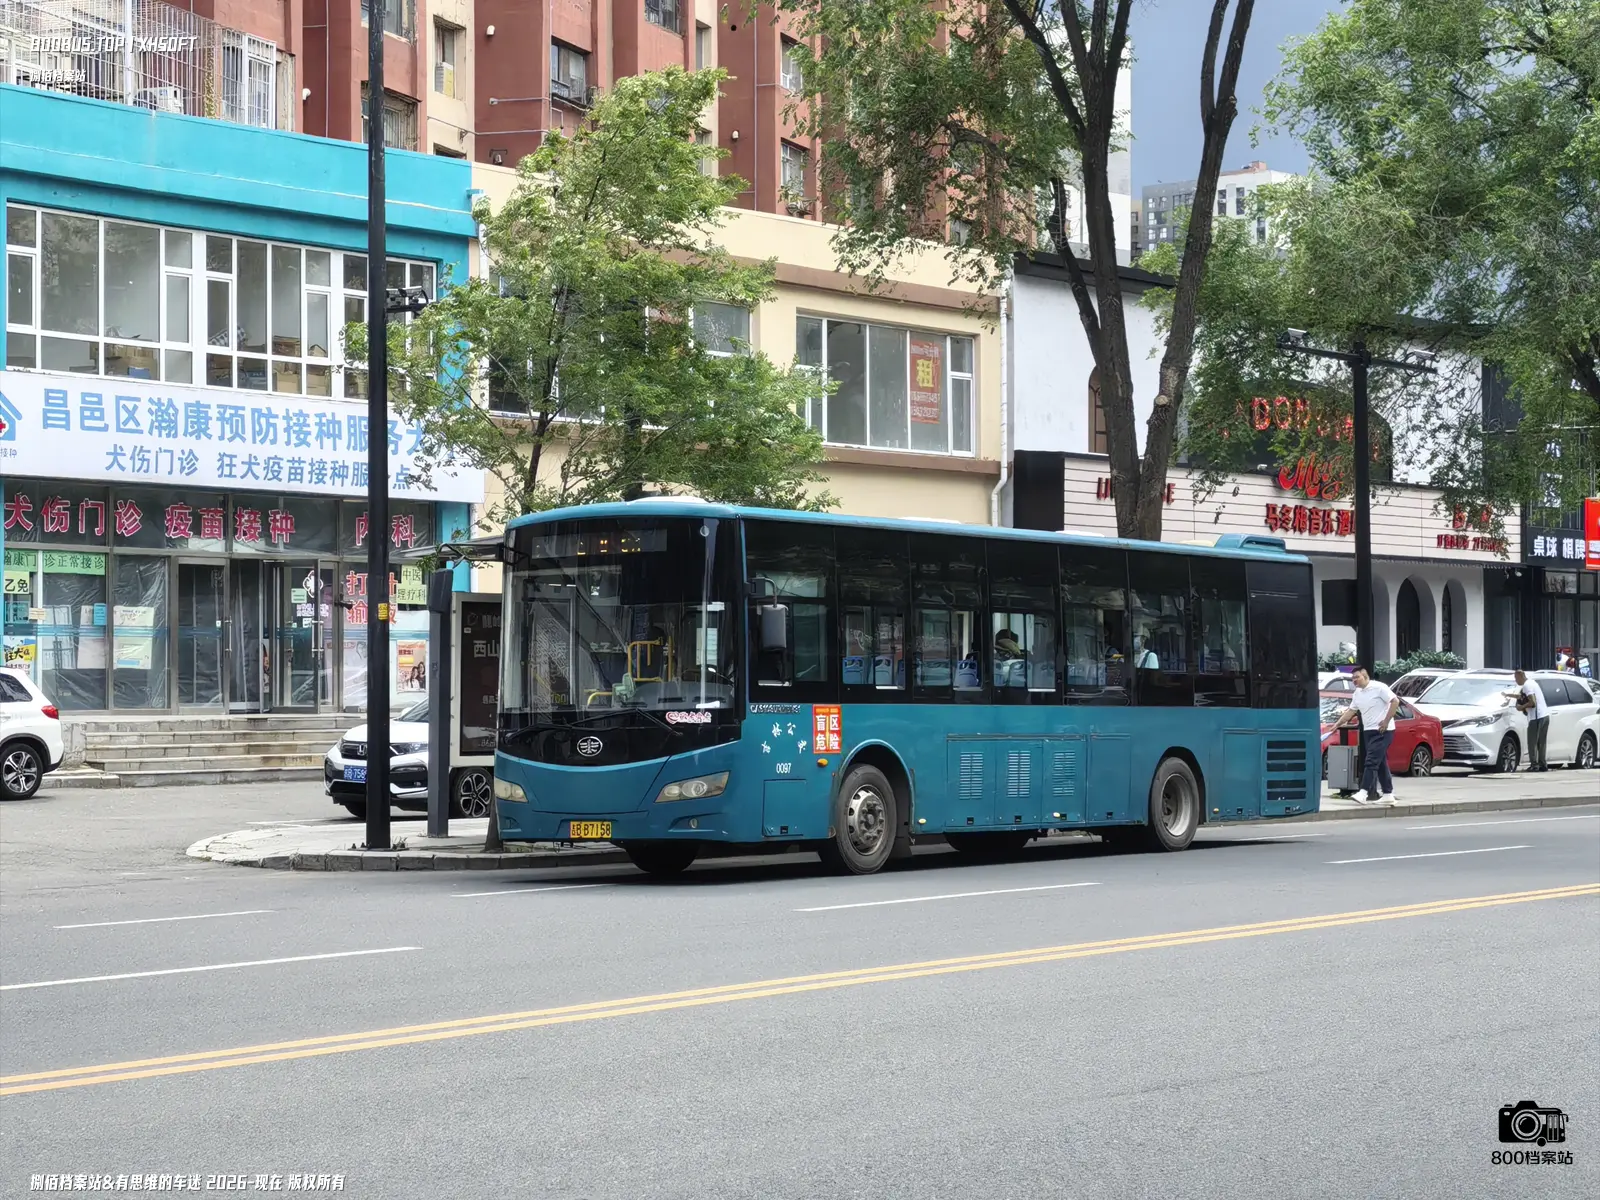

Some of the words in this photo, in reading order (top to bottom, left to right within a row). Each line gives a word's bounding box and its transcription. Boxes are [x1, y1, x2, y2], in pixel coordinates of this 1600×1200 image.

[42, 388, 455, 461] 昌邑区瀚康预防接种服务大
[105, 443, 200, 477] 犬伤门诊
[216, 451, 411, 490] 狂犬疫苗接种服点
[4, 492, 143, 537] 犬伤门诊
[164, 502, 296, 544] 疫苗接种
[1265, 503, 1356, 536] 马冬梅音乐酒
[1533, 535, 1558, 558] 桌球
[4, 578, 29, 593] 乙免
[815, 714, 840, 731] 盲区
[815, 732, 840, 751] 危险
[775, 762, 792, 774] 0097
